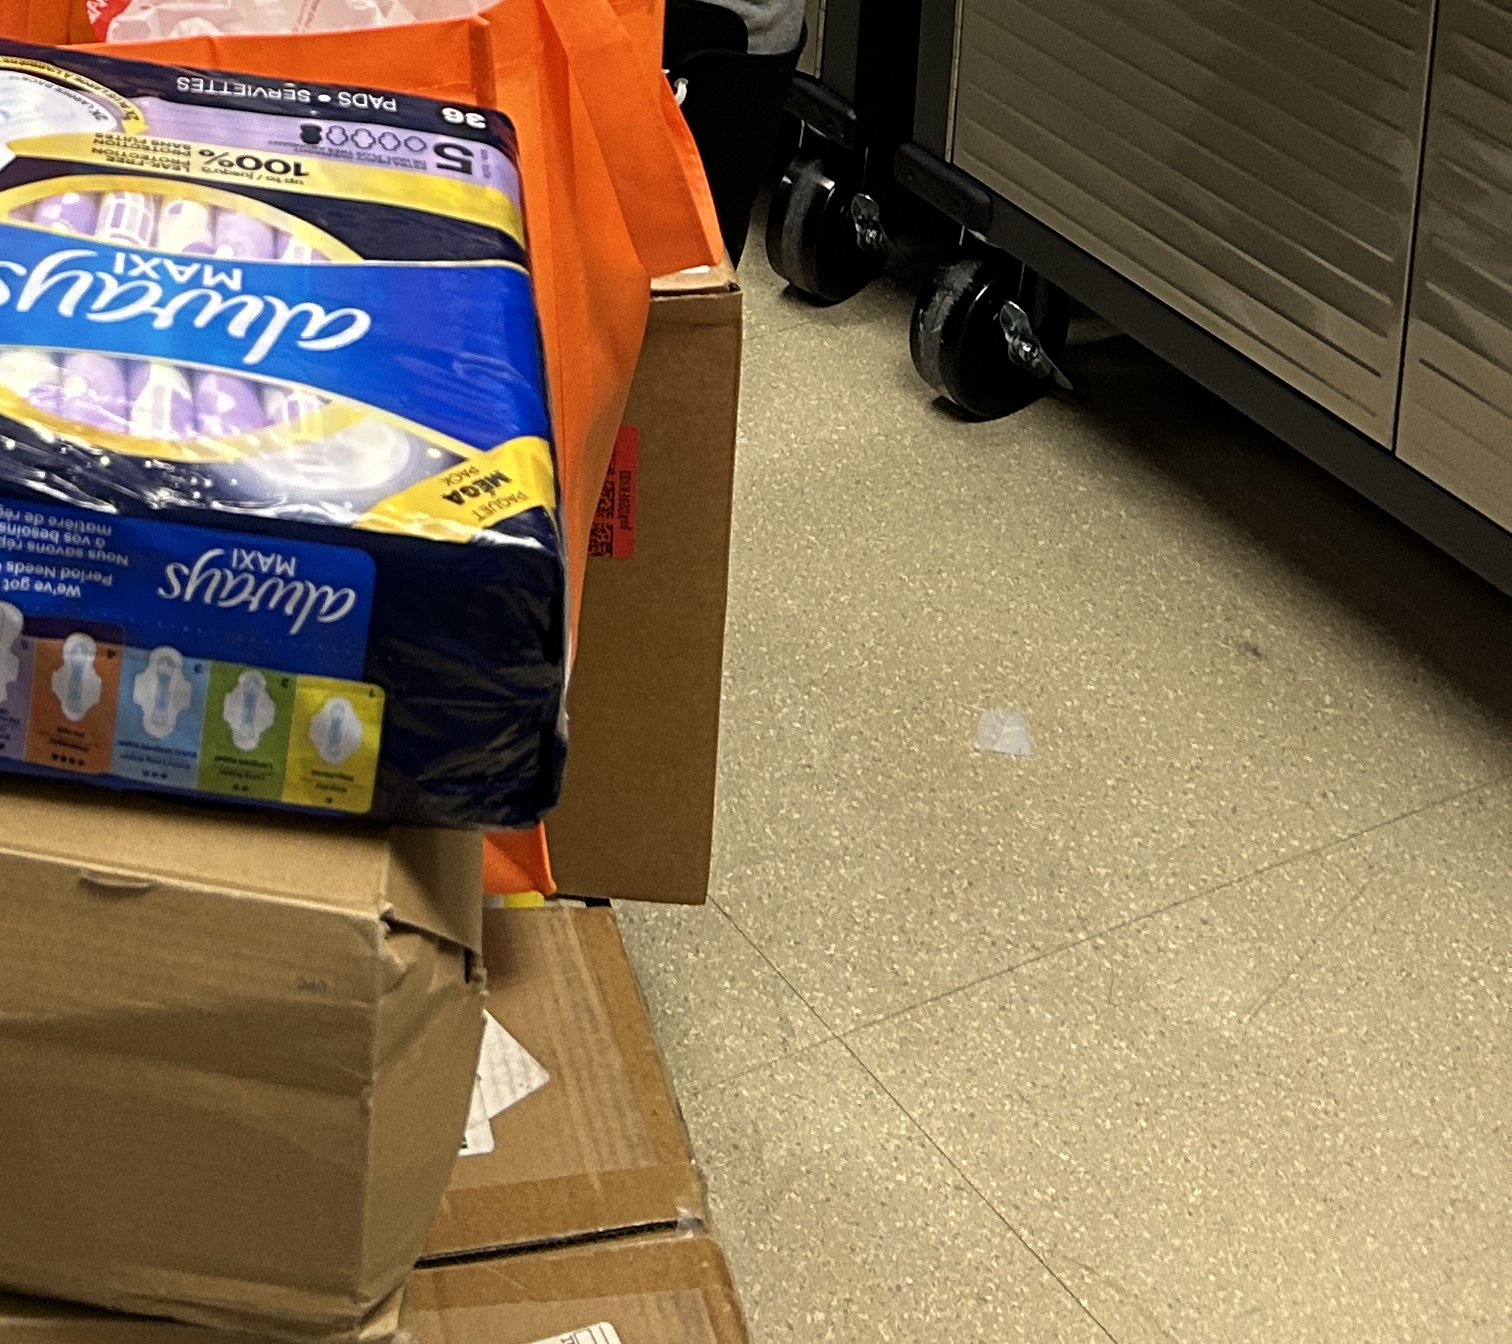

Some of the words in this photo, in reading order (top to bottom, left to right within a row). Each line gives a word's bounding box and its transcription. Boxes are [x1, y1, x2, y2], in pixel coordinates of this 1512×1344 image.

[176, 75, 311, 103] SERVIETTES
[338, 90, 398, 113] PADS
[440, 107, 487, 129] 36
[198, 149, 310, 177] 100%
[433, 143, 474, 175] 5
[112, 251, 243, 292] MAXI
[439, 465, 480, 486] PACK
[471, 490, 529, 522] PAQUET
[25, 515, 45, 530] de
[48, 516, 112, 538] matière
[26, 541, 85, 560] savons
[64, 532, 92, 547] vos
[87, 550, 129, 568] Nous
[231, 548, 296, 576] MAXI
[5, 561, 56, 580] Needs
[60, 566, 114, 586] Period
[3, 576, 31, 592] got
[34, 580, 82, 598] We've
[156, 548, 356, 635] always
